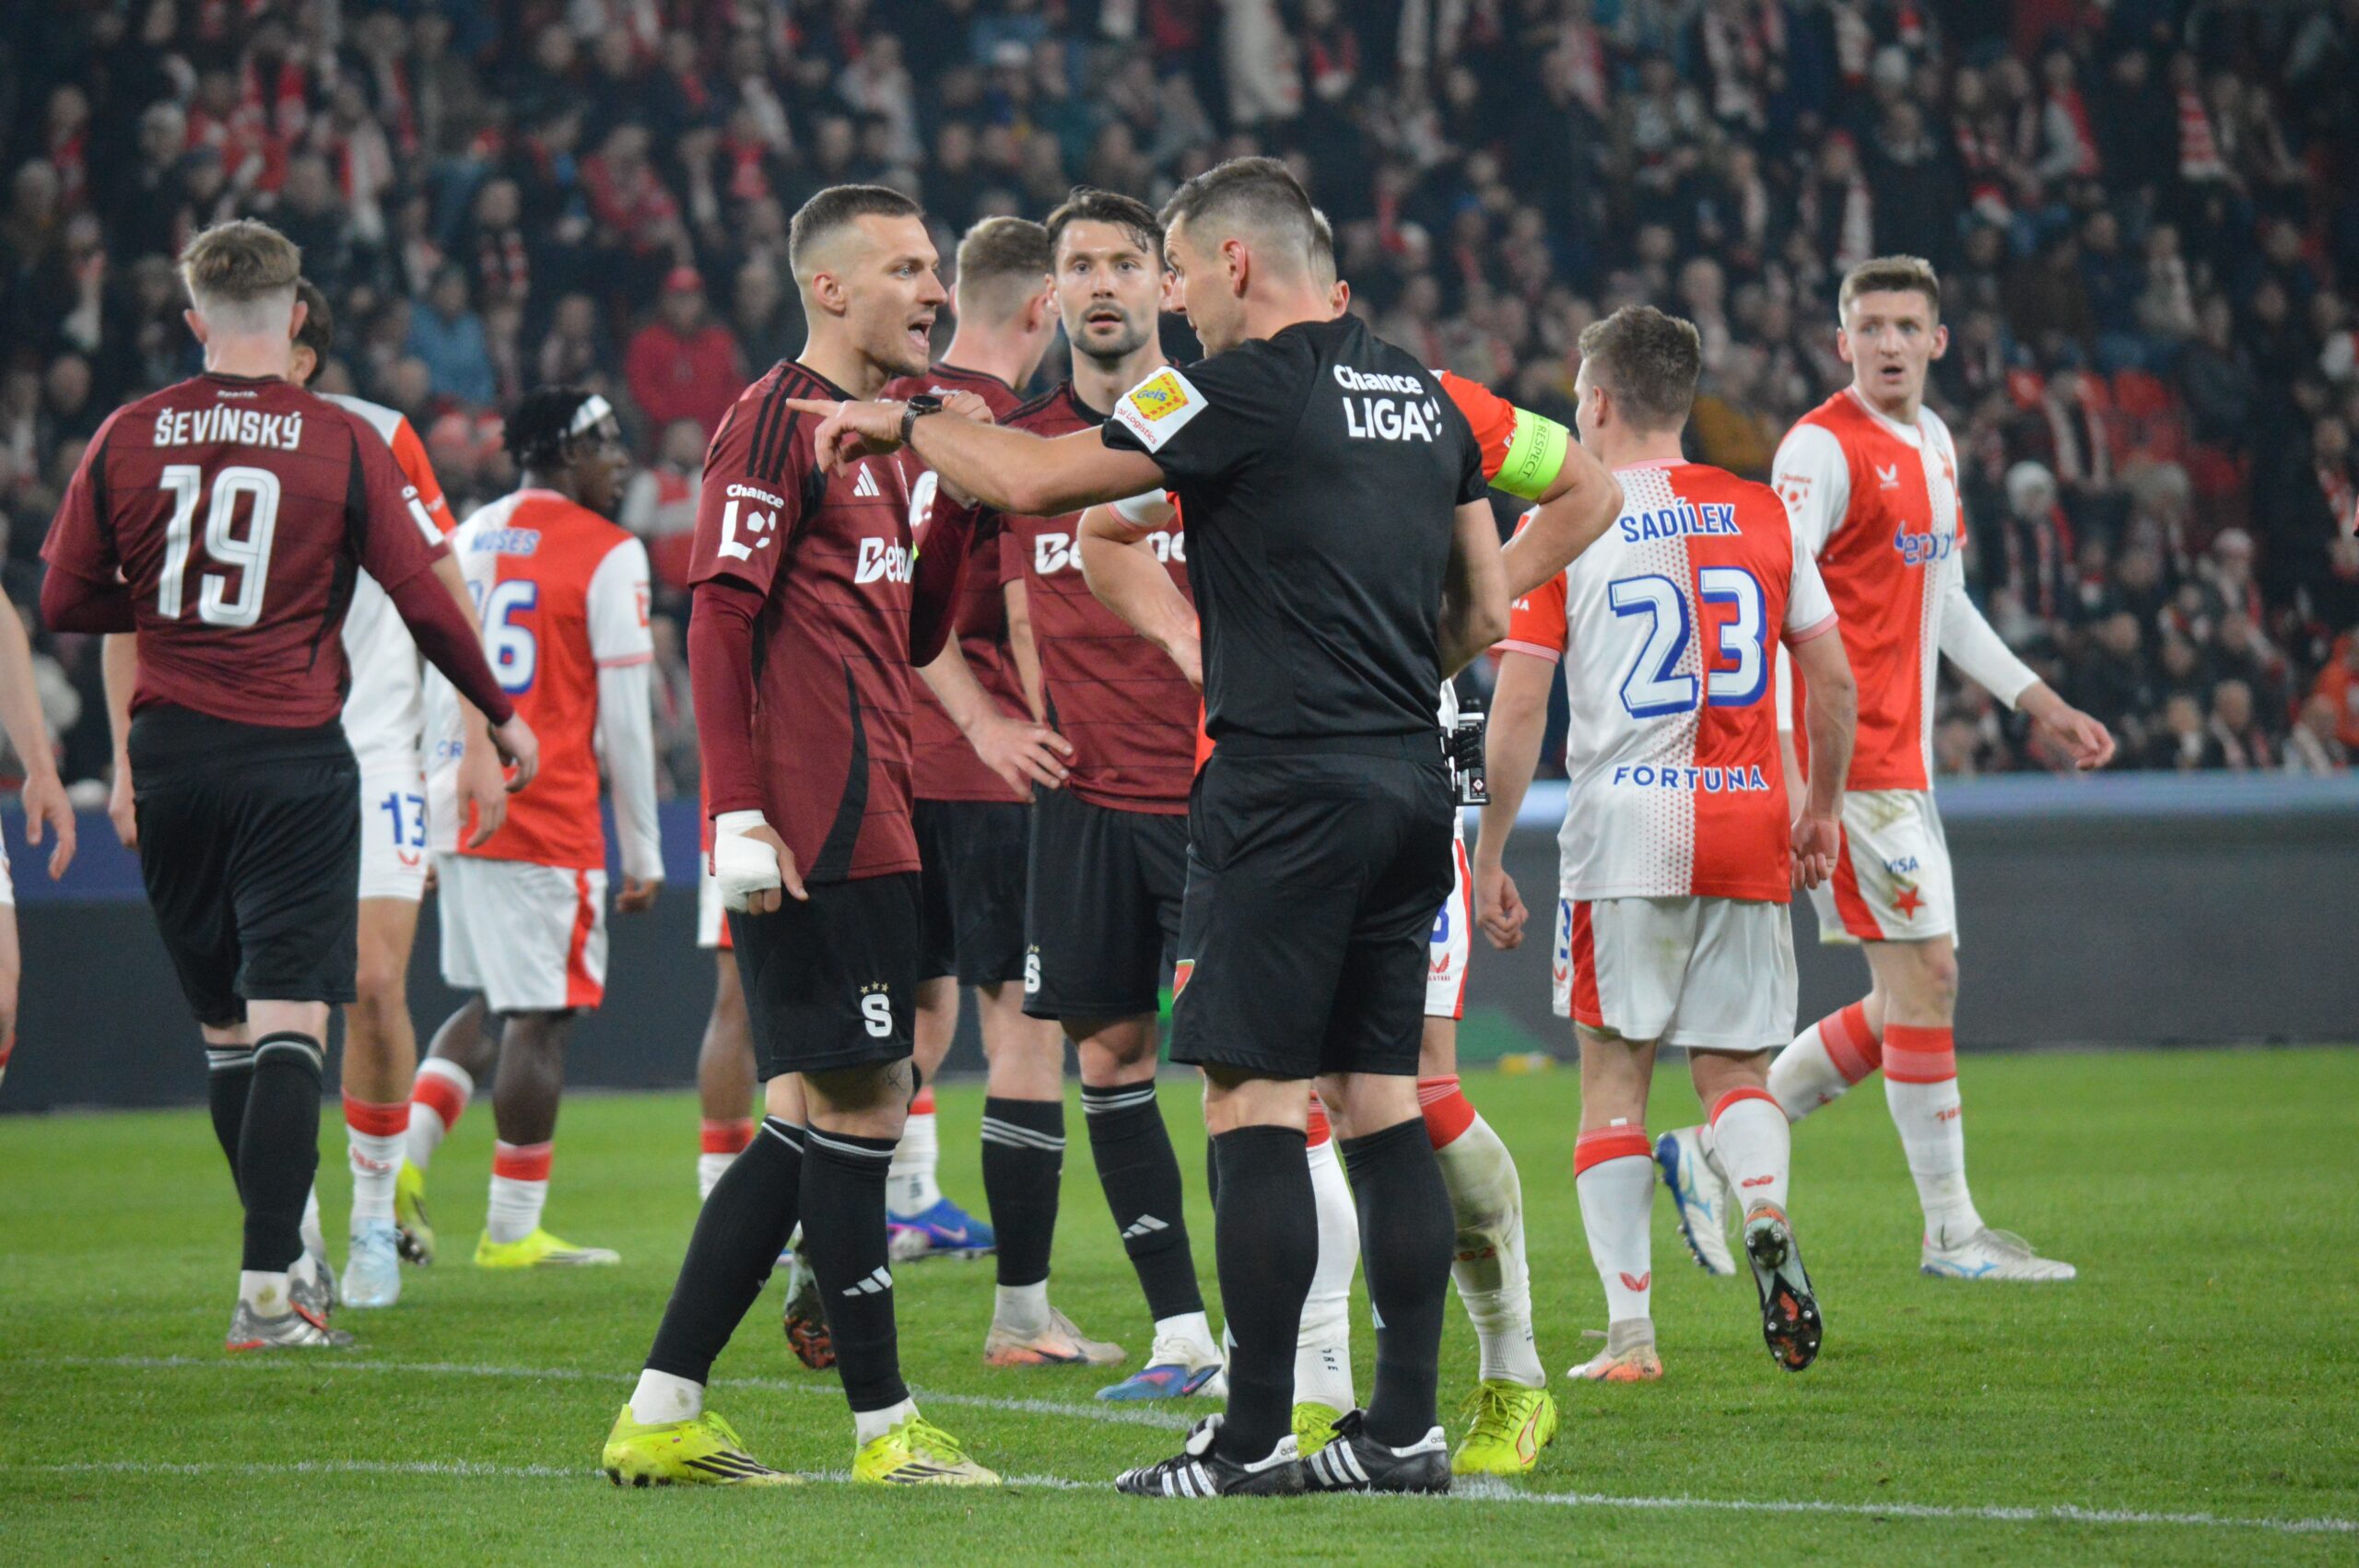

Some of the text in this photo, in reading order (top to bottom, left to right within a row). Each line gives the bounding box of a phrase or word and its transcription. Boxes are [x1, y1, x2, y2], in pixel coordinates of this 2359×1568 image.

[1136, 388, 1168, 402] Geis
[1333, 364, 1424, 394] Chance
[1126, 411, 1157, 444] Logistics
[1343, 397, 1433, 442] LIGA
[1522, 425, 1548, 478] RESPECT
[726, 484, 784, 509] Chance
[1619, 497, 1741, 544] SADÍLEK
[158, 464, 280, 626] 19
[472, 528, 541, 556] MOSES
[1608, 567, 1767, 719] 23
[1614, 765, 1767, 792] FORTUNA
[381, 792, 426, 847] 13
[1883, 856, 1919, 873] VISA
[862, 994, 892, 1037] S
